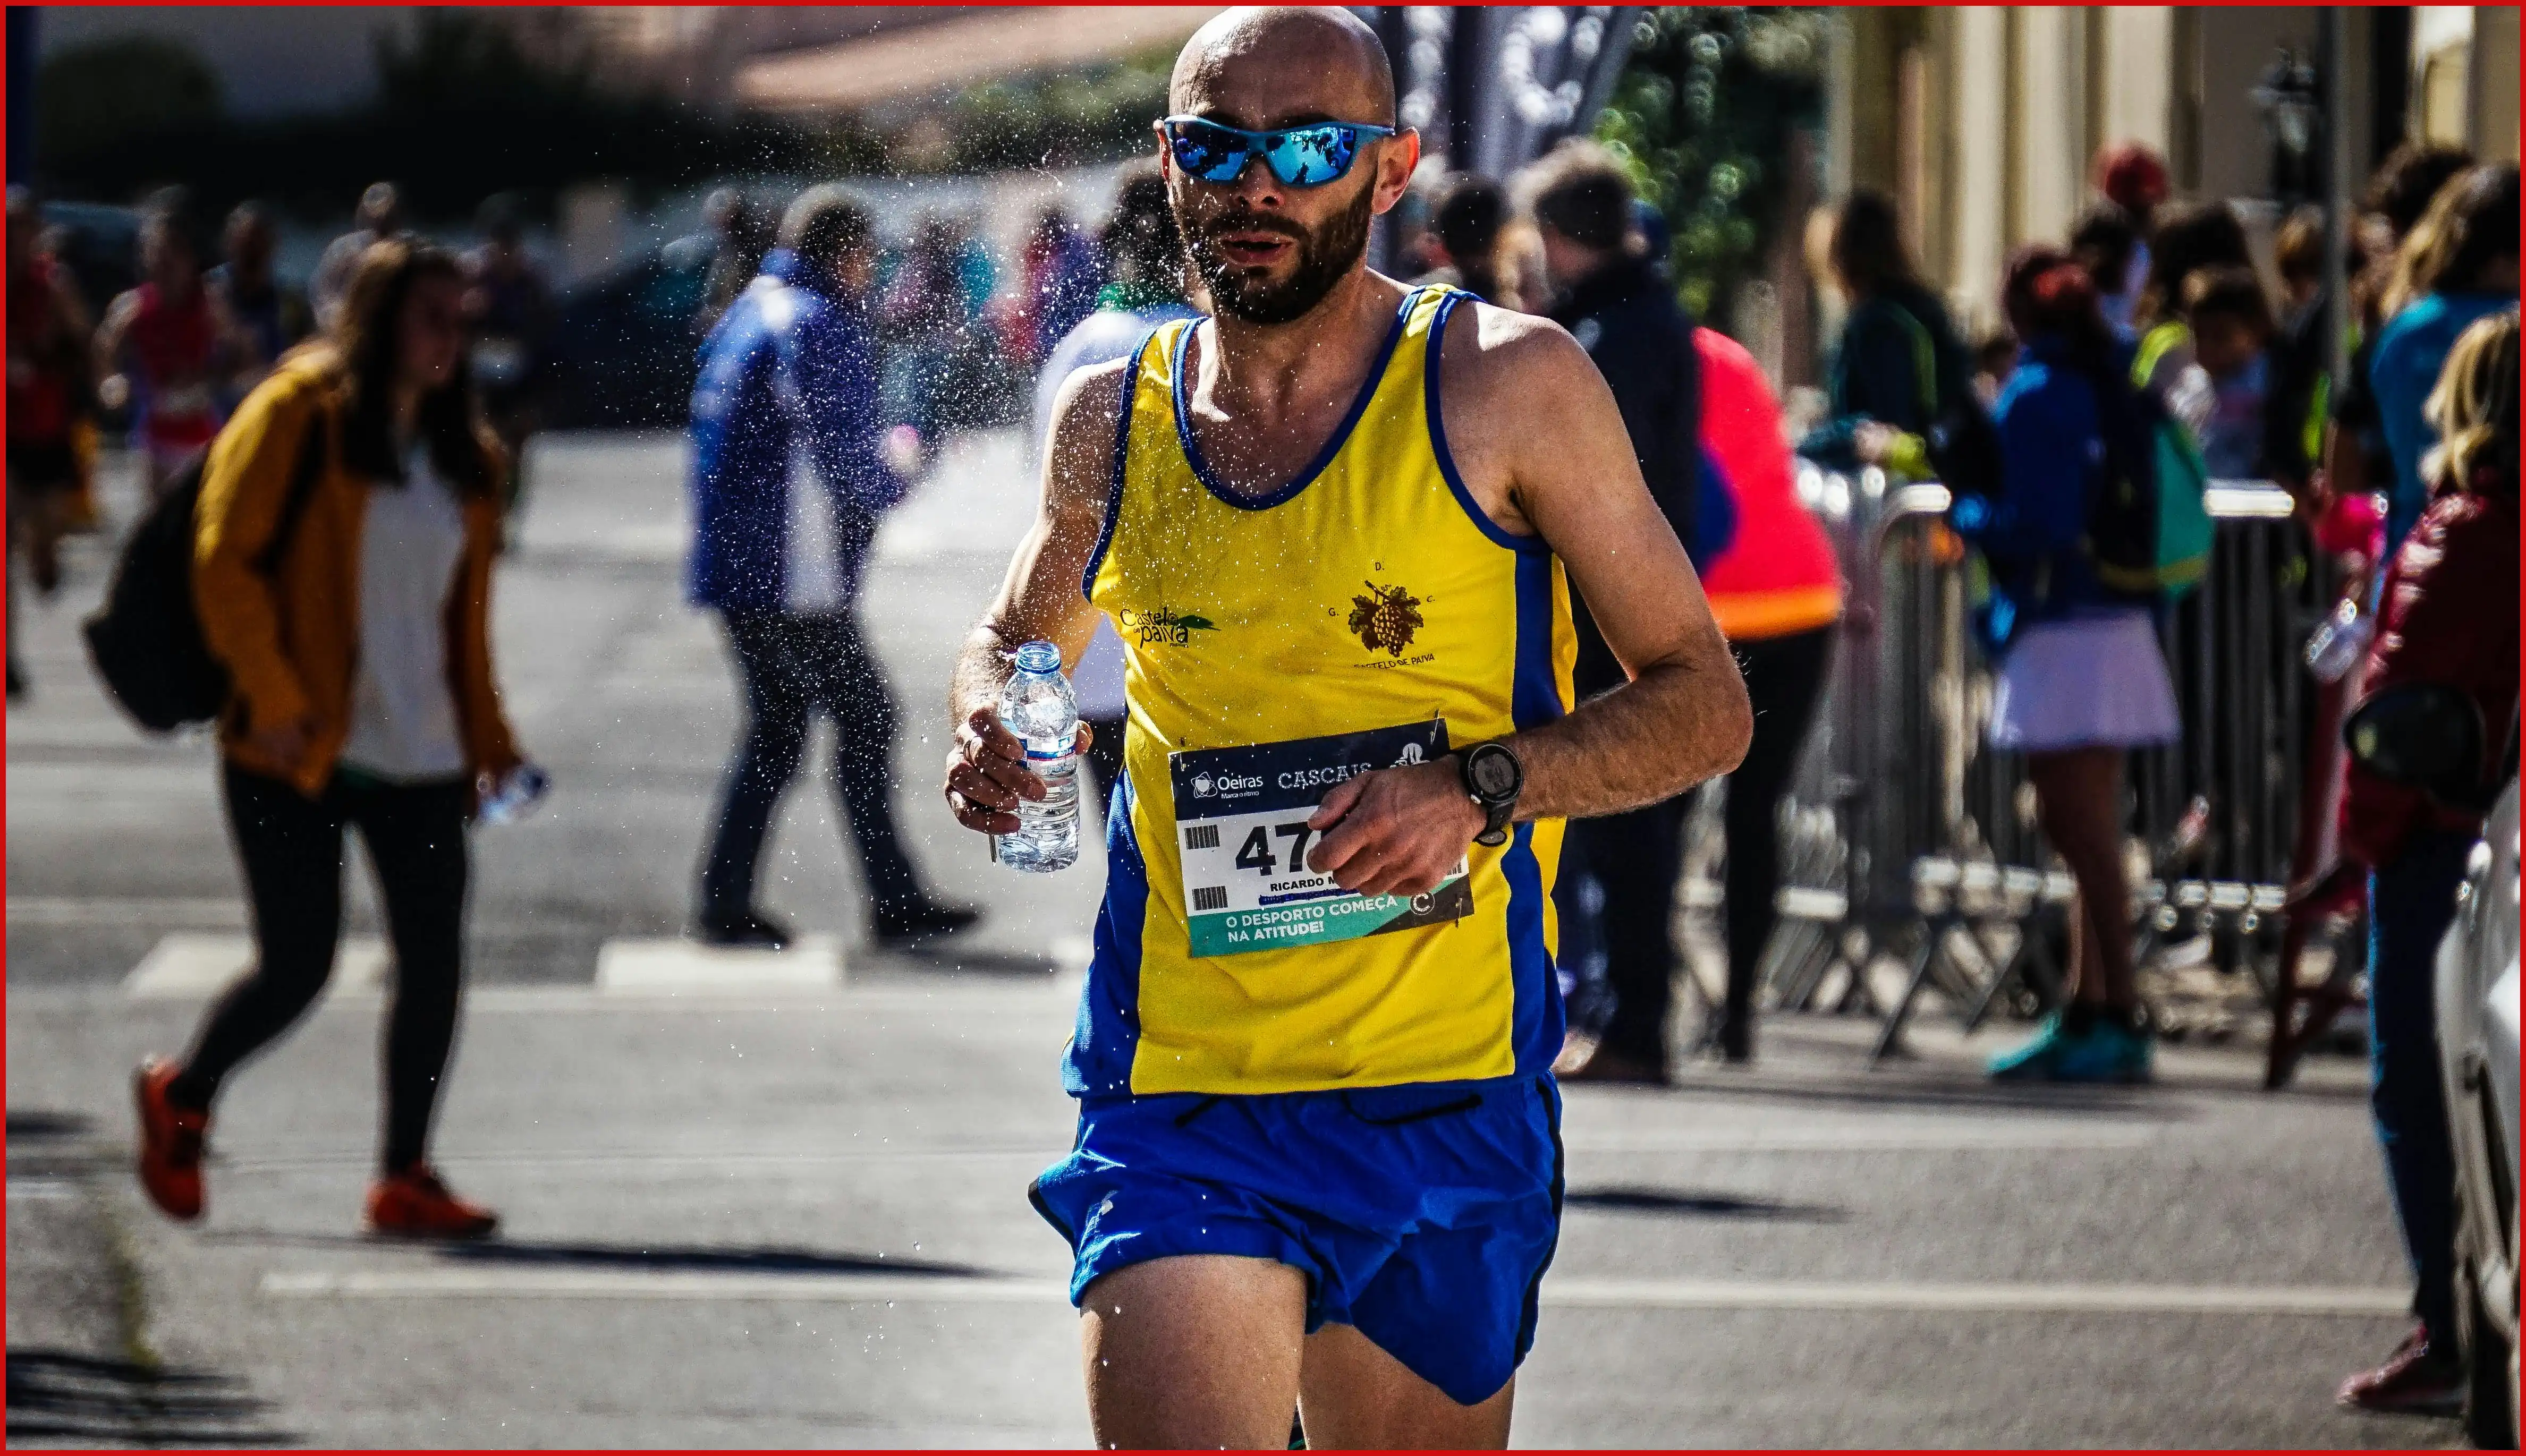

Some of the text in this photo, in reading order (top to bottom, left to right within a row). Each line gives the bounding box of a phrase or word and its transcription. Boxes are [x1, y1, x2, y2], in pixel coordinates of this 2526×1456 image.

[1375, 562, 1385, 571] D.
[1120, 606, 1179, 626] Castelo
[1328, 607, 1339, 616] G.
[1140, 625, 1189, 649] paiva
[1411, 653, 1435, 665] PAIVA
[1217, 775, 1264, 790] Oeiras
[1235, 821, 1327, 876] 47
[1270, 878, 1324, 892] RICARDO
[1226, 916, 1237, 929] O
[1242, 905, 1325, 927] DESPORTO
[1329, 895, 1398, 916] COMEÇA
[1228, 920, 1325, 943] NA ATITUDE!
